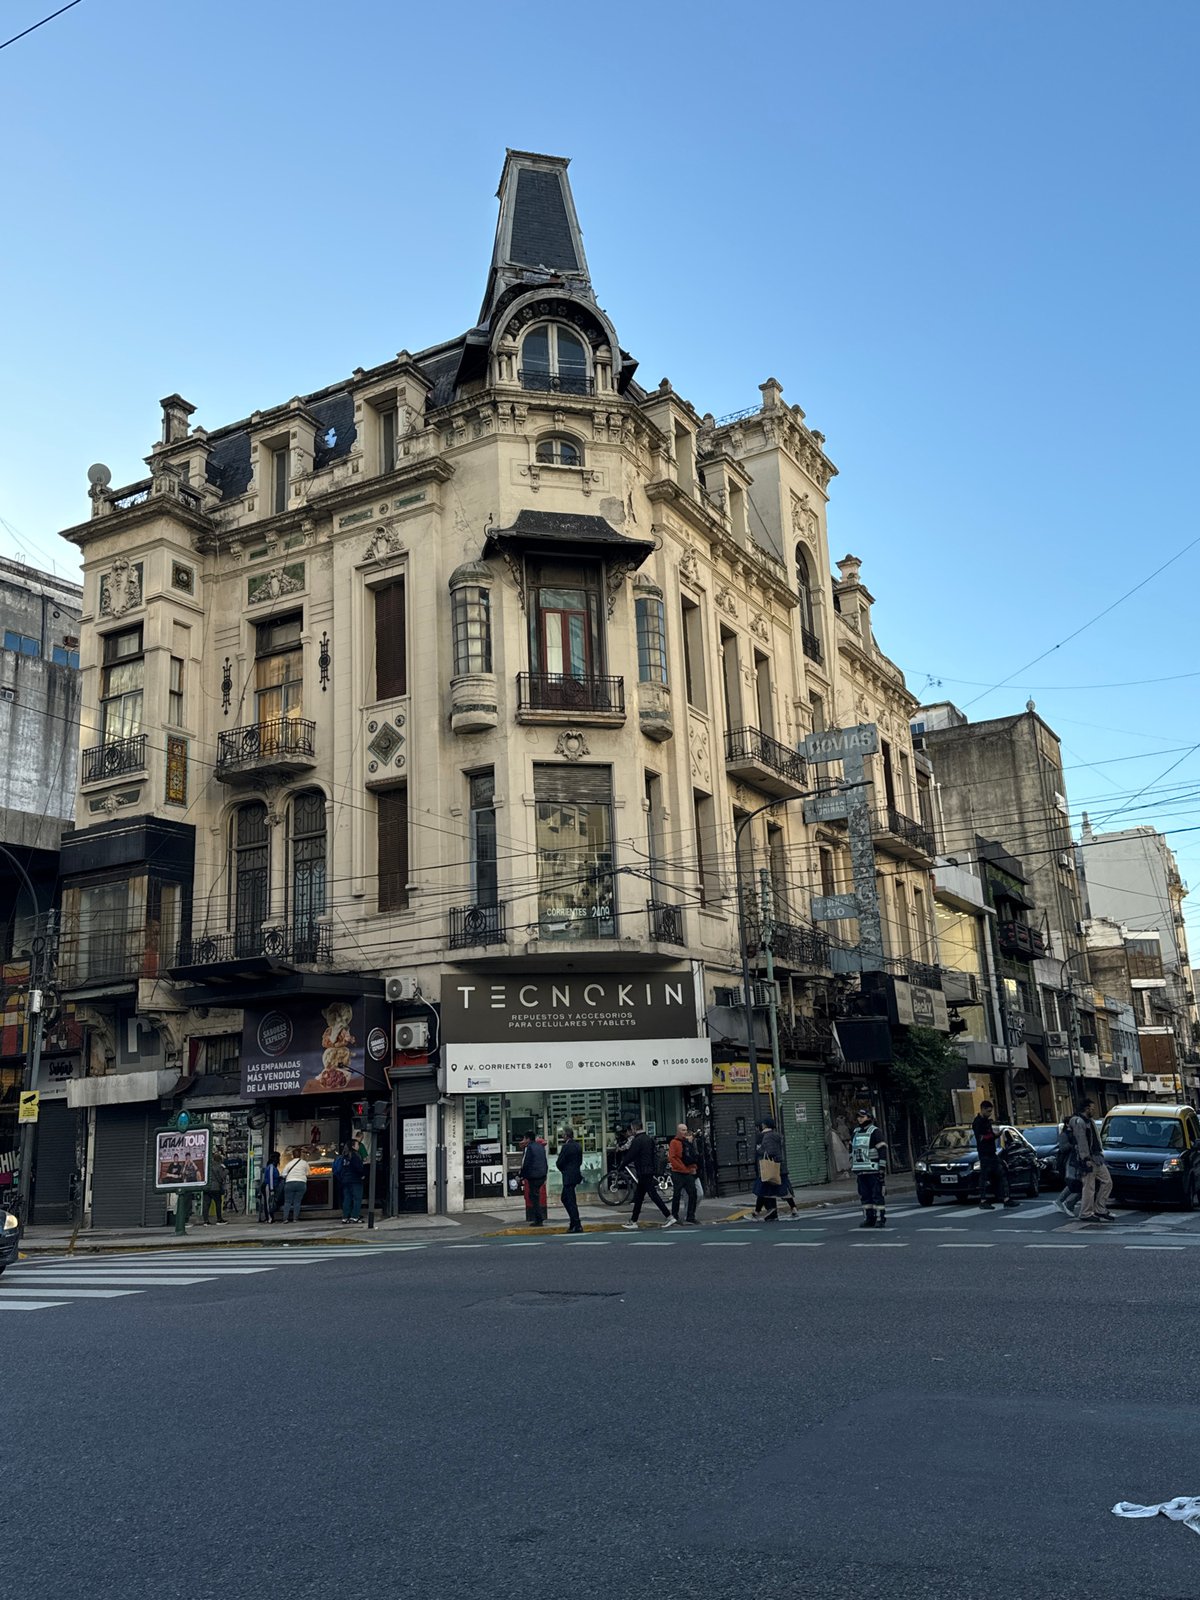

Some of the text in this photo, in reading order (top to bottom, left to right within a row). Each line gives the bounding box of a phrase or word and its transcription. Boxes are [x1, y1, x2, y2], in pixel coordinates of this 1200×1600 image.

[546, 907, 587, 917] CORRIENTES
[824, 907, 845, 917] 410
[457, 982, 683, 1009] TECNOKIN
[511, 1011, 634, 1021] REPUESTOS Y ACCESORIOS
[508, 1018, 636, 1029] PARA CELULARES Y TABLETS
[262, 1024, 287, 1039] SABORES
[265, 1031, 288, 1045] EXPRESS
[247, 1060, 301, 1072] LAS EMPANADAS
[479, 1062, 533, 1071] CORRIENTES
[534, 1062, 552, 1070] 2401
[578, 1060, 636, 1068] @TECNOKINBA
[671, 1057, 689, 1065] 5060
[690, 1056, 709, 1065] 5060
[247, 1069, 301, 1083] MÁS VENDIDAS
[246, 1081, 300, 1093] DE LA HISTORIA
[159, 1134, 206, 1149] LATAM TOUR
